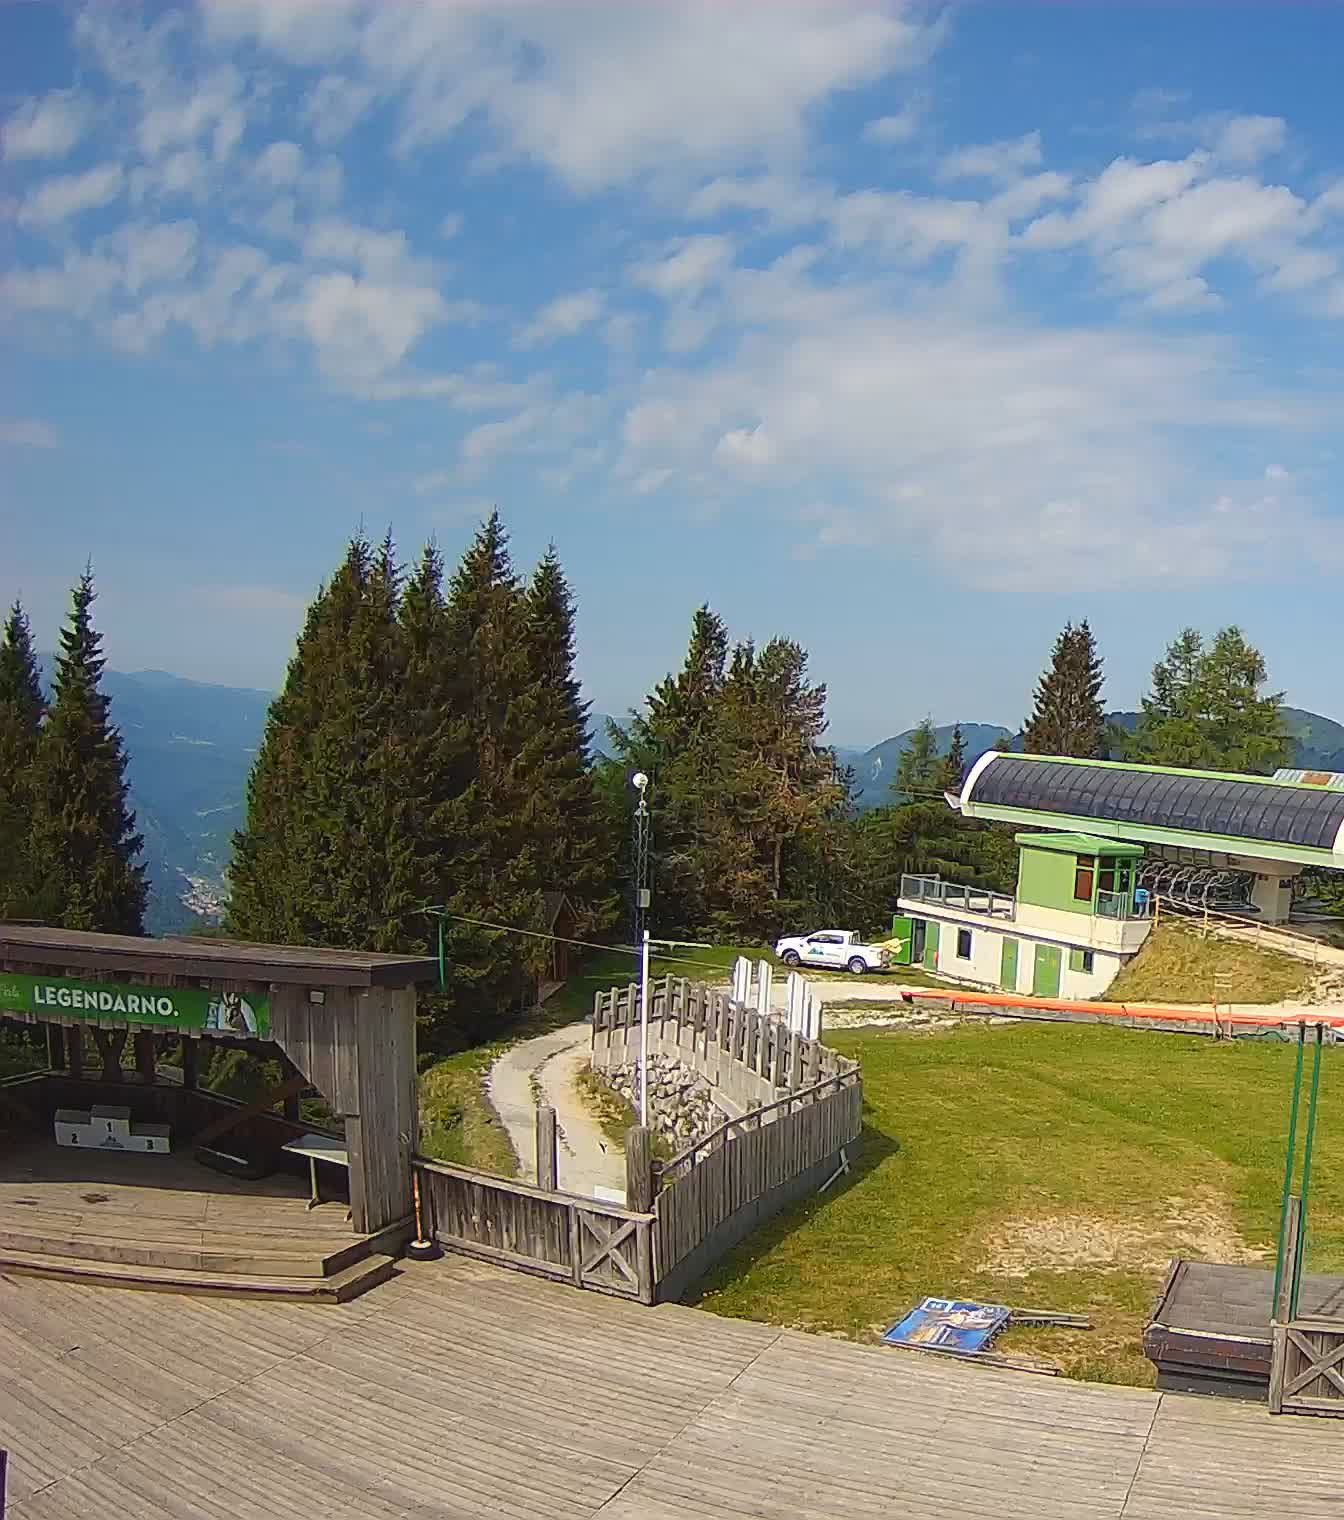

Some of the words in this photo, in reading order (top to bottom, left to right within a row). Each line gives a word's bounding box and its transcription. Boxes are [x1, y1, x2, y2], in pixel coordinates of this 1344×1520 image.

[34, 984, 179, 1017] LEGENDARNO.
[105, 1120, 113, 1133] 1
[71, 1132, 79, 1144] 2
[146, 1139, 154, 1150] 3
